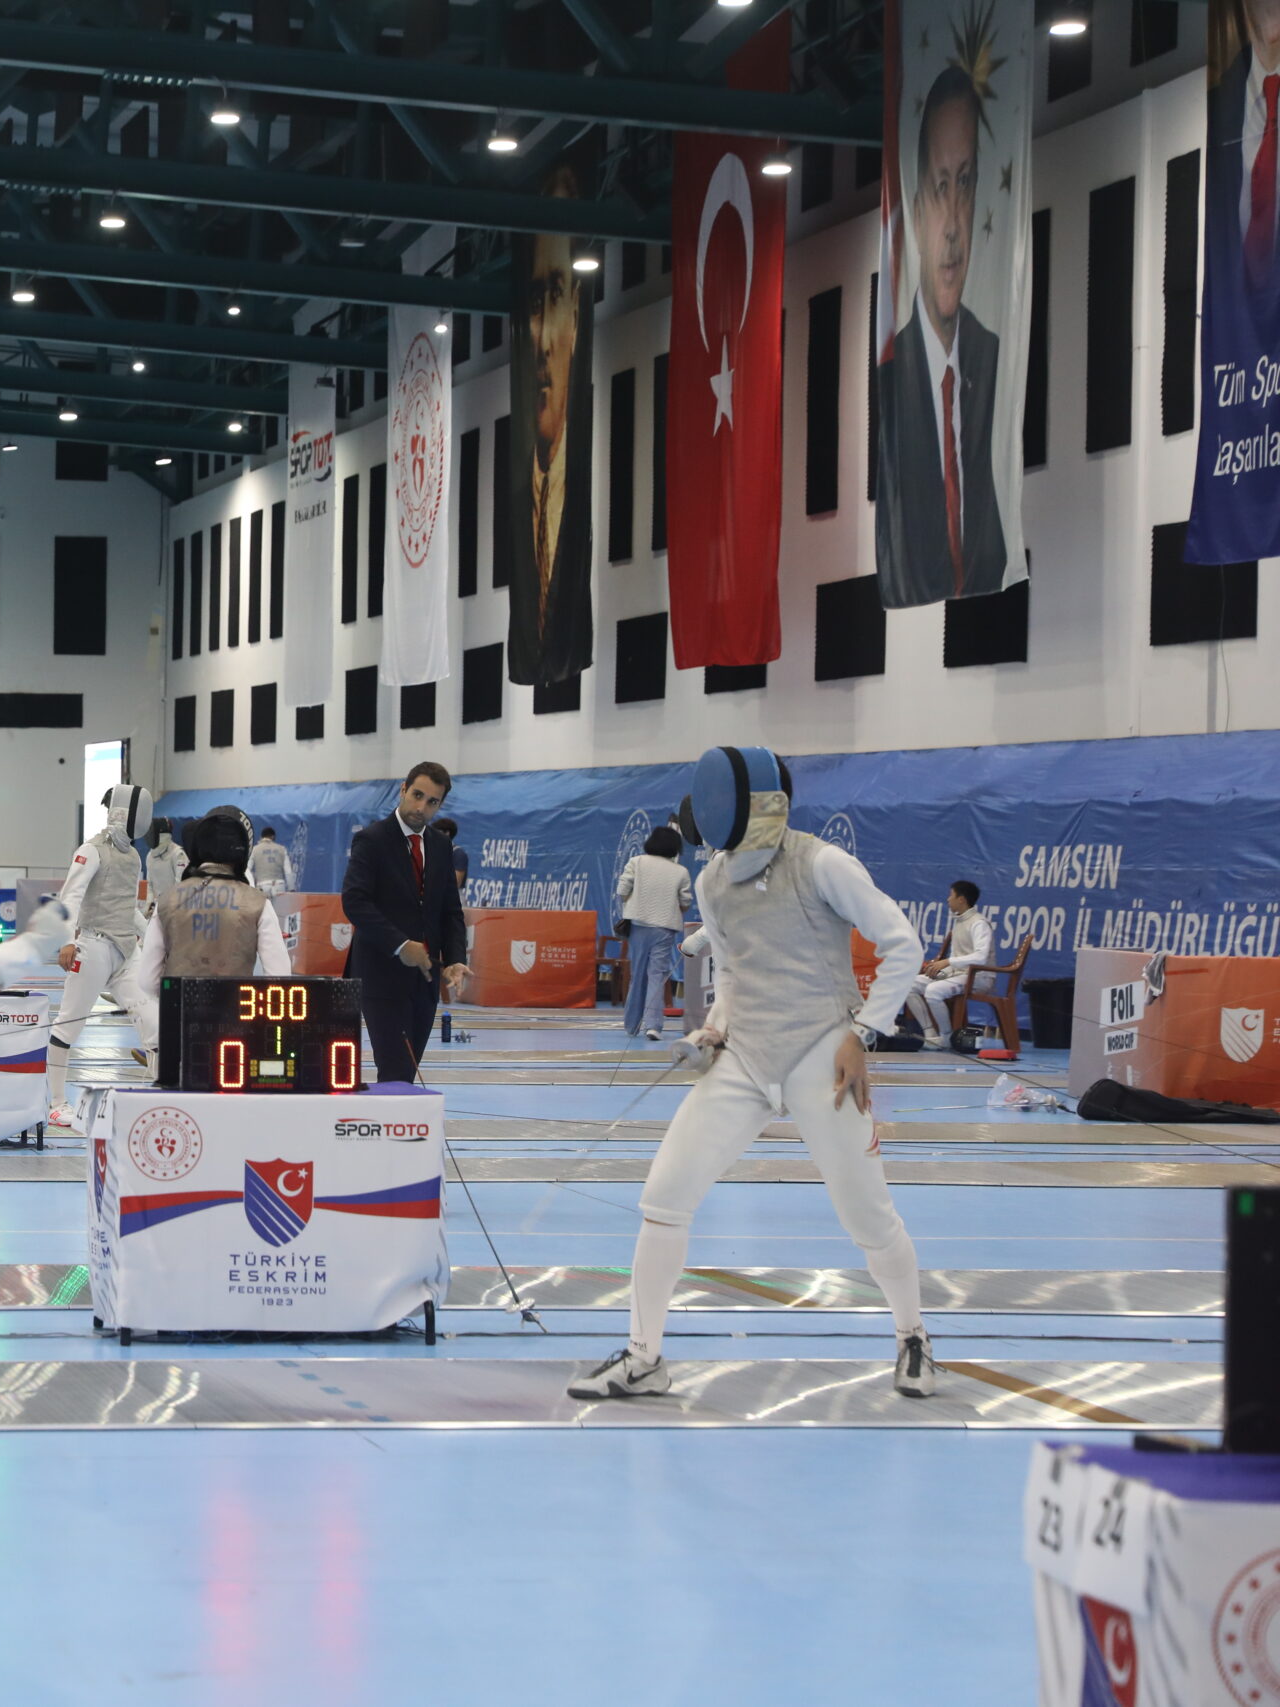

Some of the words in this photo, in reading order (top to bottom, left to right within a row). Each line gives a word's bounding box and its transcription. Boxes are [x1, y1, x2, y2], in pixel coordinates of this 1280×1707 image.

[480, 838, 529, 869] SAMSUN
[1015, 843, 1123, 889] SAMSUN
[473, 879, 503, 908] SPOR
[191, 912, 220, 941] PHI
[999, 905, 1066, 950] SPOR
[1073, 896, 1095, 952] İL
[1100, 898, 1280, 957] MÜDÜRLÜĞÜ
[239, 985, 308, 1020] 3:00
[1110, 984, 1135, 1023] FOIL
[220, 1041, 245, 1089] 0
[331, 1041, 356, 1089] 0
[229, 1252, 326, 1267] TÜRKİYE
[228, 1268, 326, 1283] ESKRİM
[228, 1286, 327, 1295] FEDERASYONU
[261, 1298, 294, 1306] 1923
